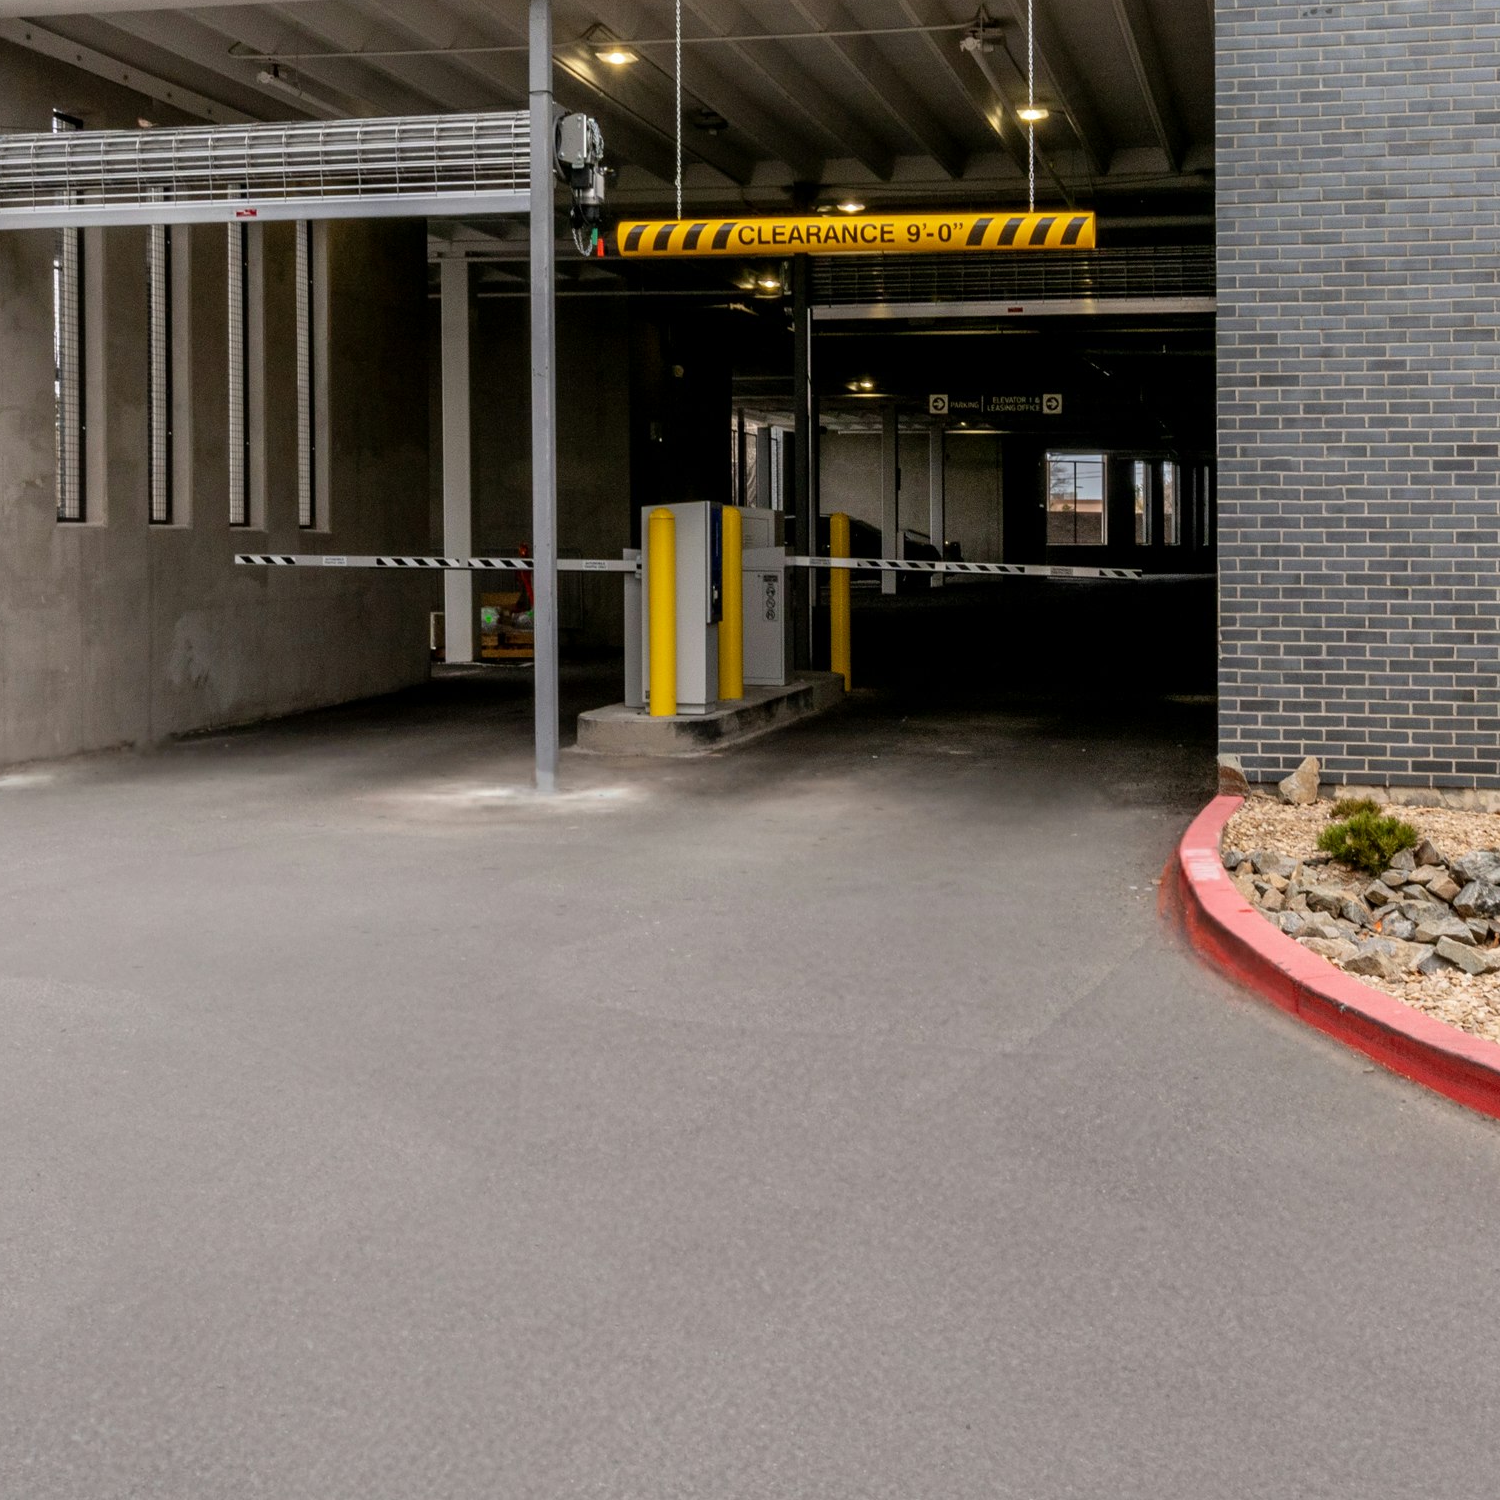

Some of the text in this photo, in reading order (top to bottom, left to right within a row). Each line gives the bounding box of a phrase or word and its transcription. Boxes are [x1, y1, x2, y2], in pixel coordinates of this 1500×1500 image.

[738, 223, 895, 245] CLEARANCE
[992, 396, 1026, 404] ELEVATOR
[950, 401, 980, 409] PARKING
[987, 403, 1040, 412] LEASING OFFICE
